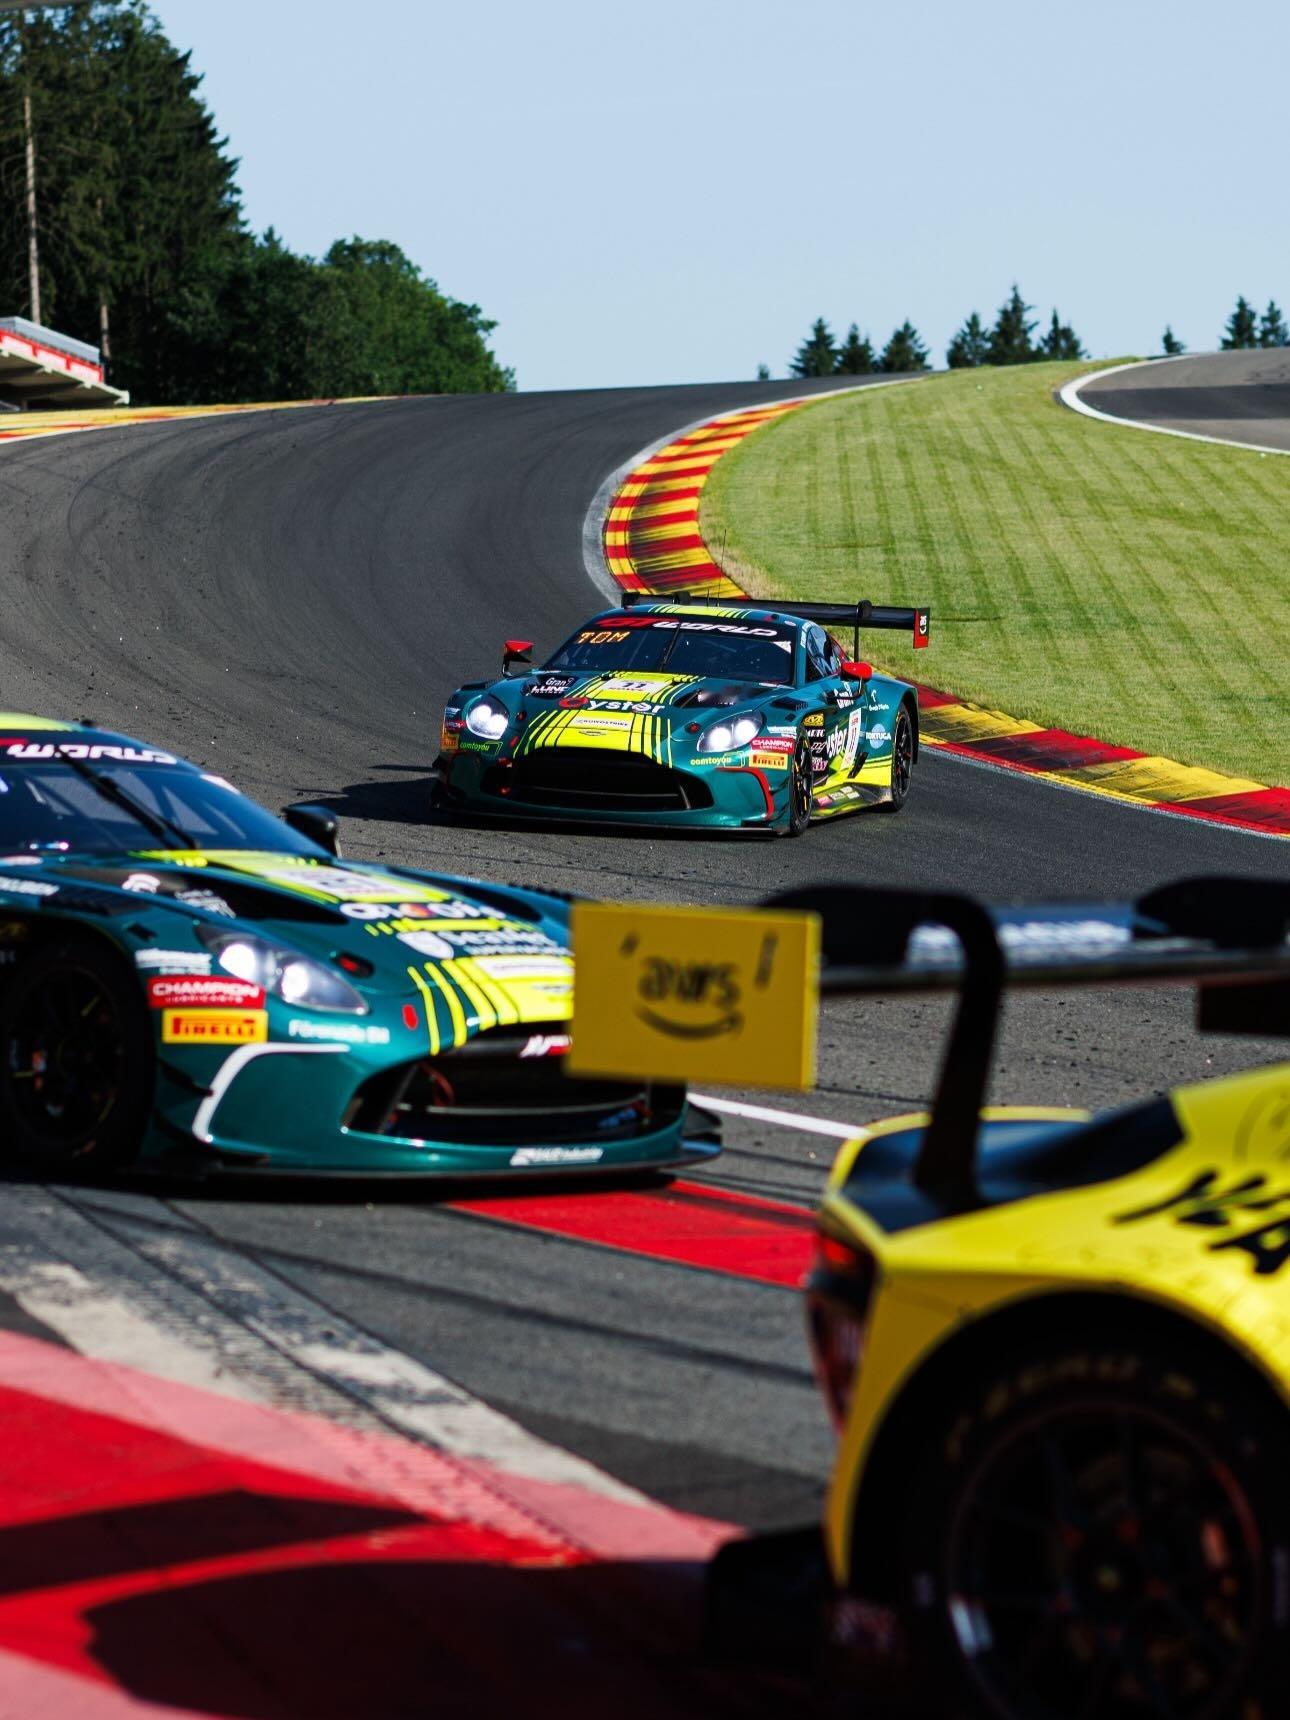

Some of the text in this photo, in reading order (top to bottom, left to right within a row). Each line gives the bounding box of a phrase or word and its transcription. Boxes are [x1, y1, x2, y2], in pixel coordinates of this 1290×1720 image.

[652, 621, 778, 636] WORLD
[577, 631, 631, 645] TOM
[752, 739, 793, 749] CHAMPION
[690, 755, 732, 766] comtoyou
[752, 754, 785, 766] PIRELLI
[152, 981, 260, 998] CHAMPION
[638, 956, 742, 1011] aws
[172, 1017, 255, 1035] PIRELLI
